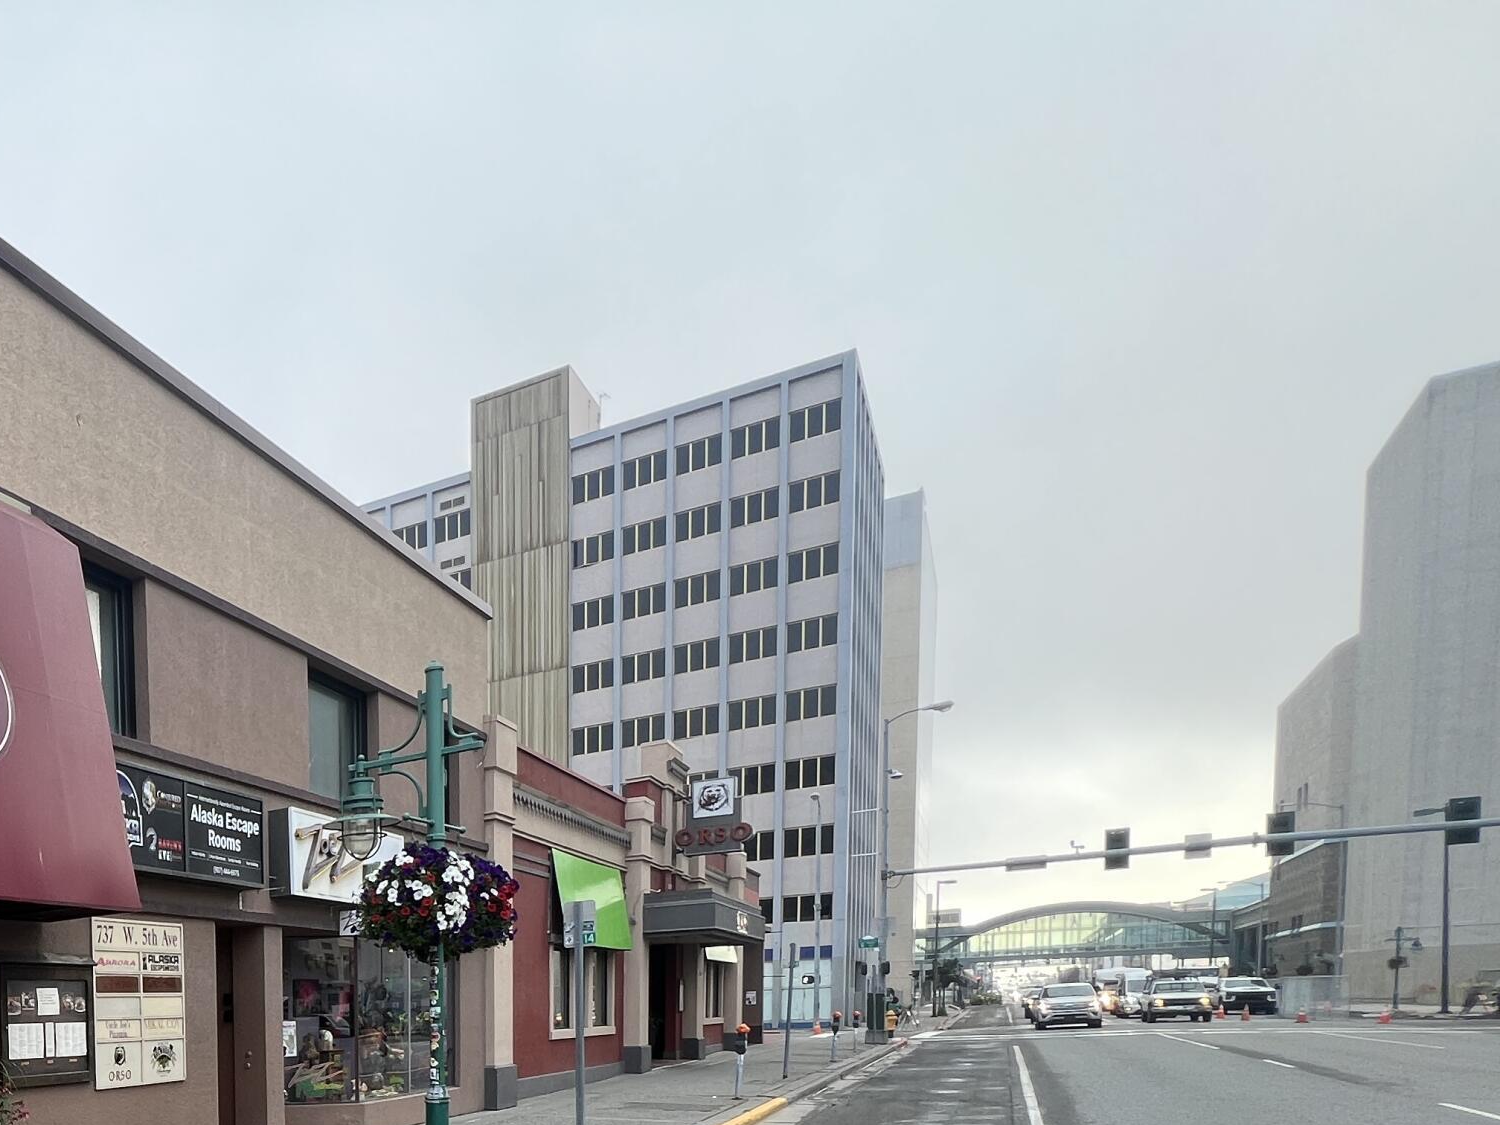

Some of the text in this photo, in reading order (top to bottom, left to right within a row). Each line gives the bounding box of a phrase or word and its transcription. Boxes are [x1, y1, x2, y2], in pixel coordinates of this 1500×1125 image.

[190, 803, 224, 828] Alaska
[225, 812, 260, 838] Escape
[208, 829, 242, 852] Rooms
[675, 822, 753, 847] ORSO
[96, 924, 178, 947] 737 W. 5th Ave
[148, 955, 179, 964] ALASKA
[108, 1069, 132, 1081] ORSO
